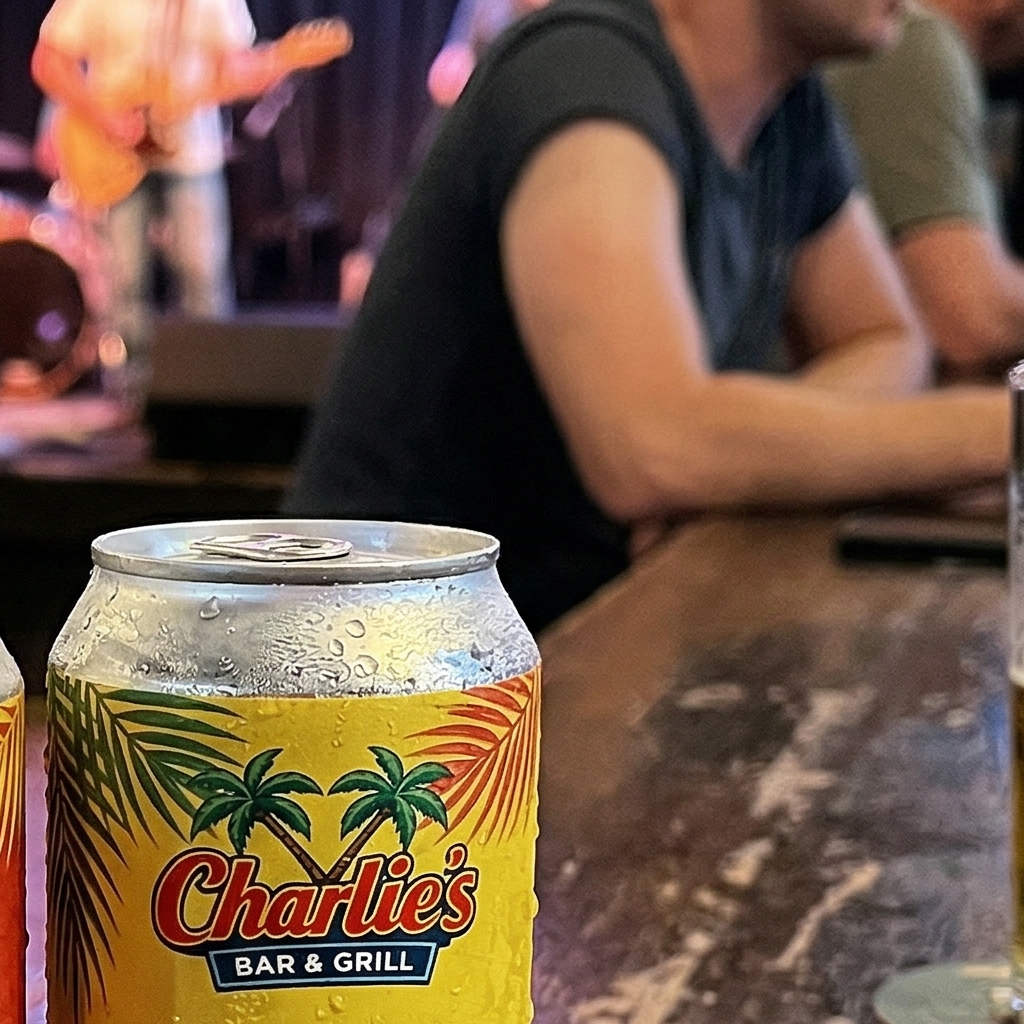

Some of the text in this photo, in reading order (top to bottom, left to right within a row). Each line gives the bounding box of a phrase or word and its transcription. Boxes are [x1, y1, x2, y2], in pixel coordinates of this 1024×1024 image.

[153, 844, 478, 950] Charlie's
[234, 950, 414, 977] BAR & GRILL
